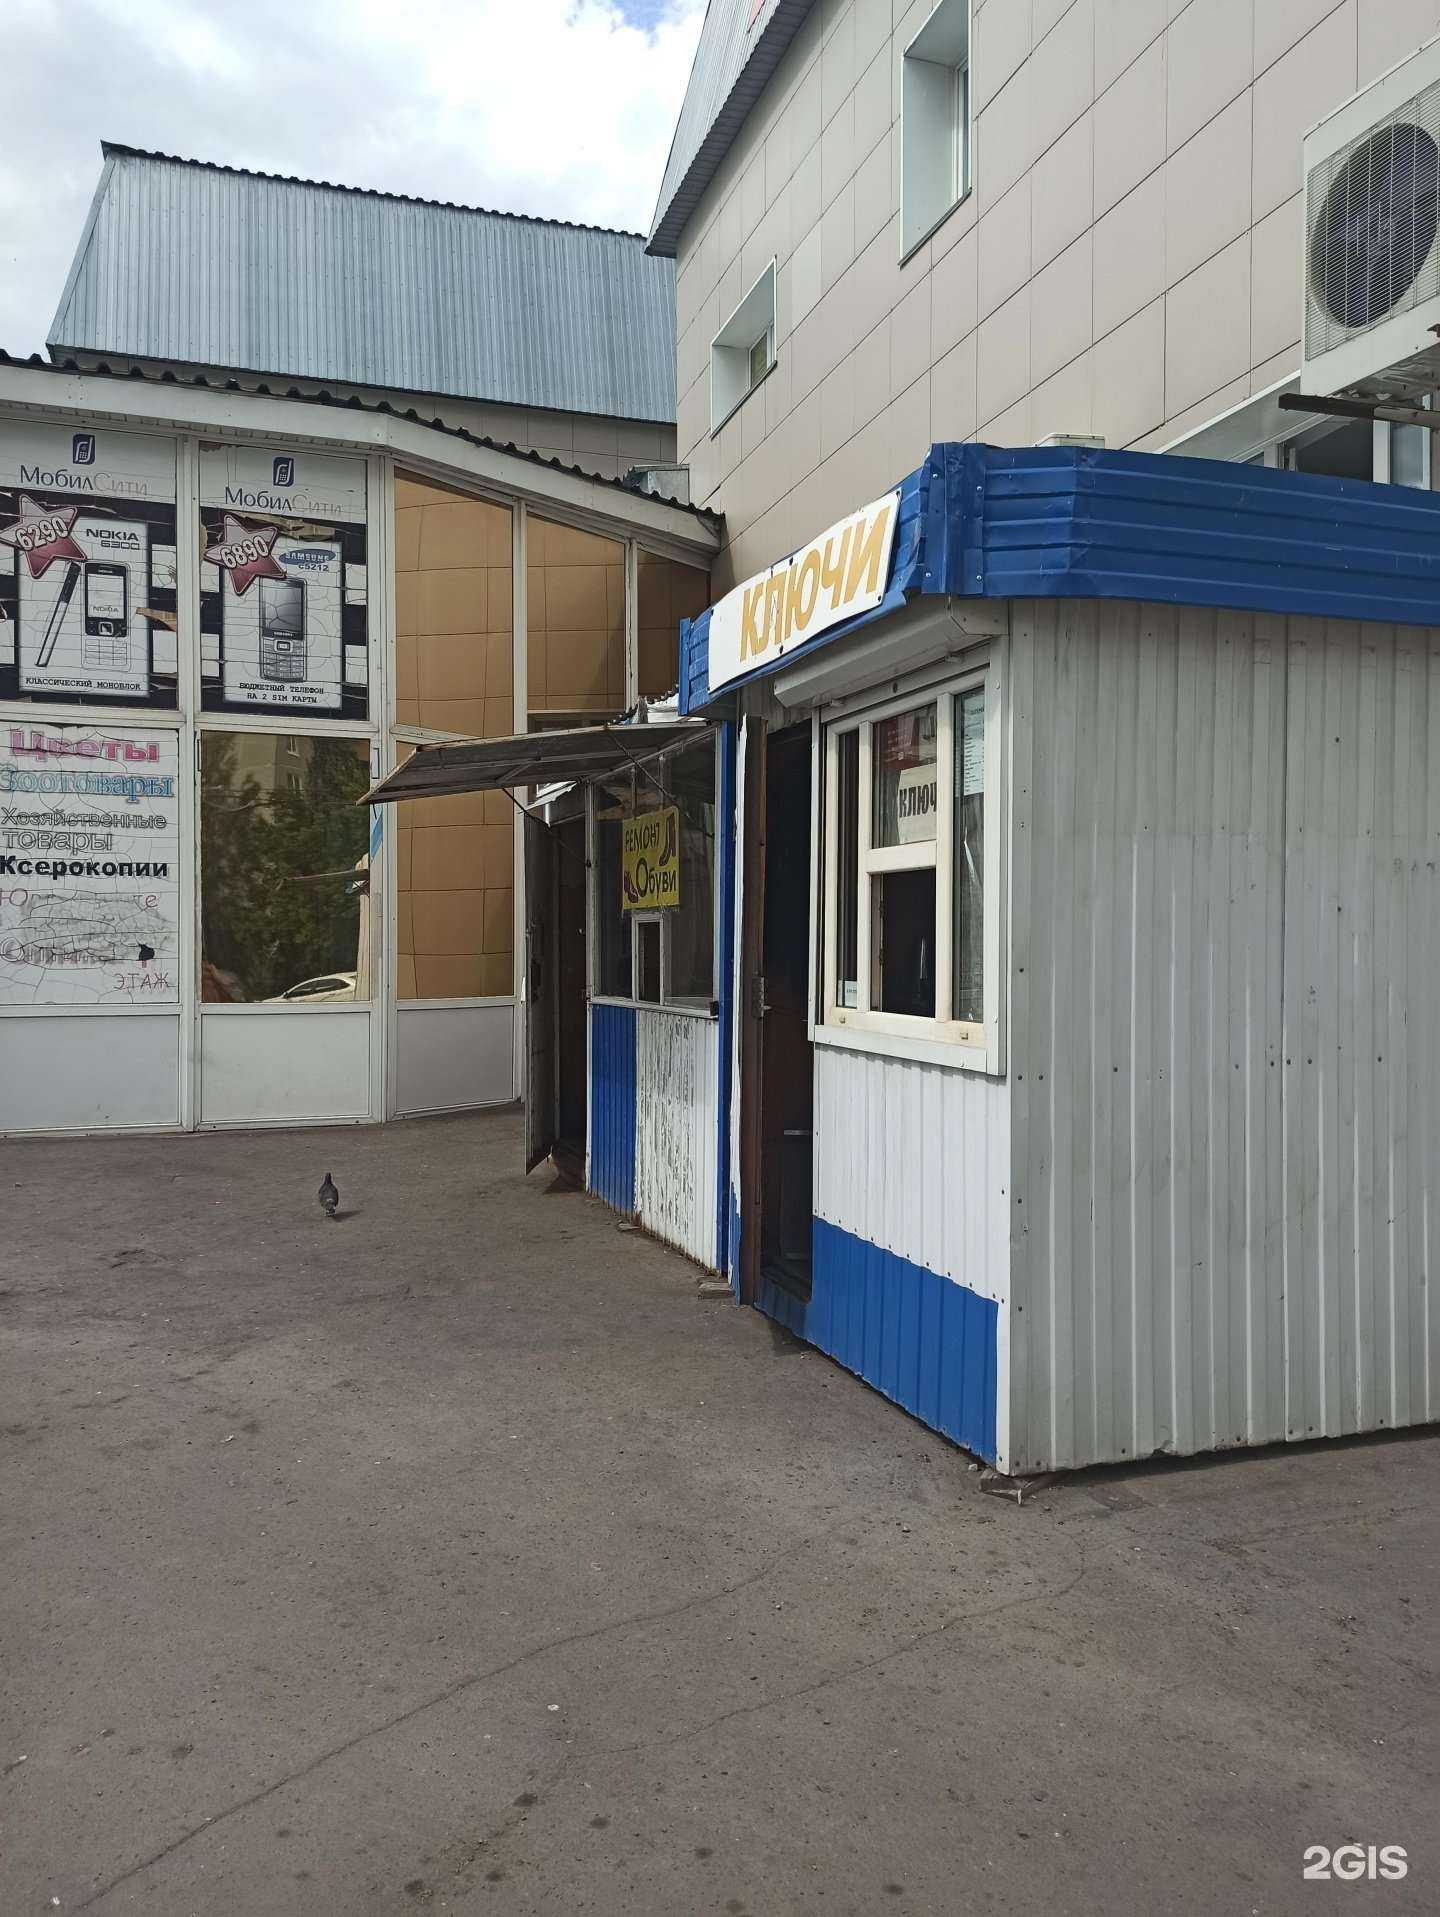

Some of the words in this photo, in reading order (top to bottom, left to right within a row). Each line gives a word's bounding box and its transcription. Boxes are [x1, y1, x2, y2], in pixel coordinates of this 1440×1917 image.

[20, 464, 149, 496] МобилСити
[225, 487, 343, 515] МобилСити
[15, 515, 69, 551] 6290
[86, 528, 139, 542] NOKIA
[100, 539, 140, 550] 6300
[220, 535, 269, 569] 6890
[285, 552, 329, 561] SAMSUNG
[298, 563, 328, 572] C5212
[740, 506, 891, 662] КЛЮЧИ
[25, 677, 93, 688] КЛАССИЧЕСКИЙ
[97, 681, 141, 690] МОНОБЛОК
[239, 683, 285, 692] БЮДЖЕТНЫЙ
[290, 686, 324, 695] ТЕЛЕФОН
[292, 696, 317, 704] КАРТЫ
[10, 730, 160, 762] Цветы
[0, 763, 174, 803] Зоотовары
[1, 807, 167, 829] Хозяйственные
[0, 855, 168, 880] Ксерокопии
